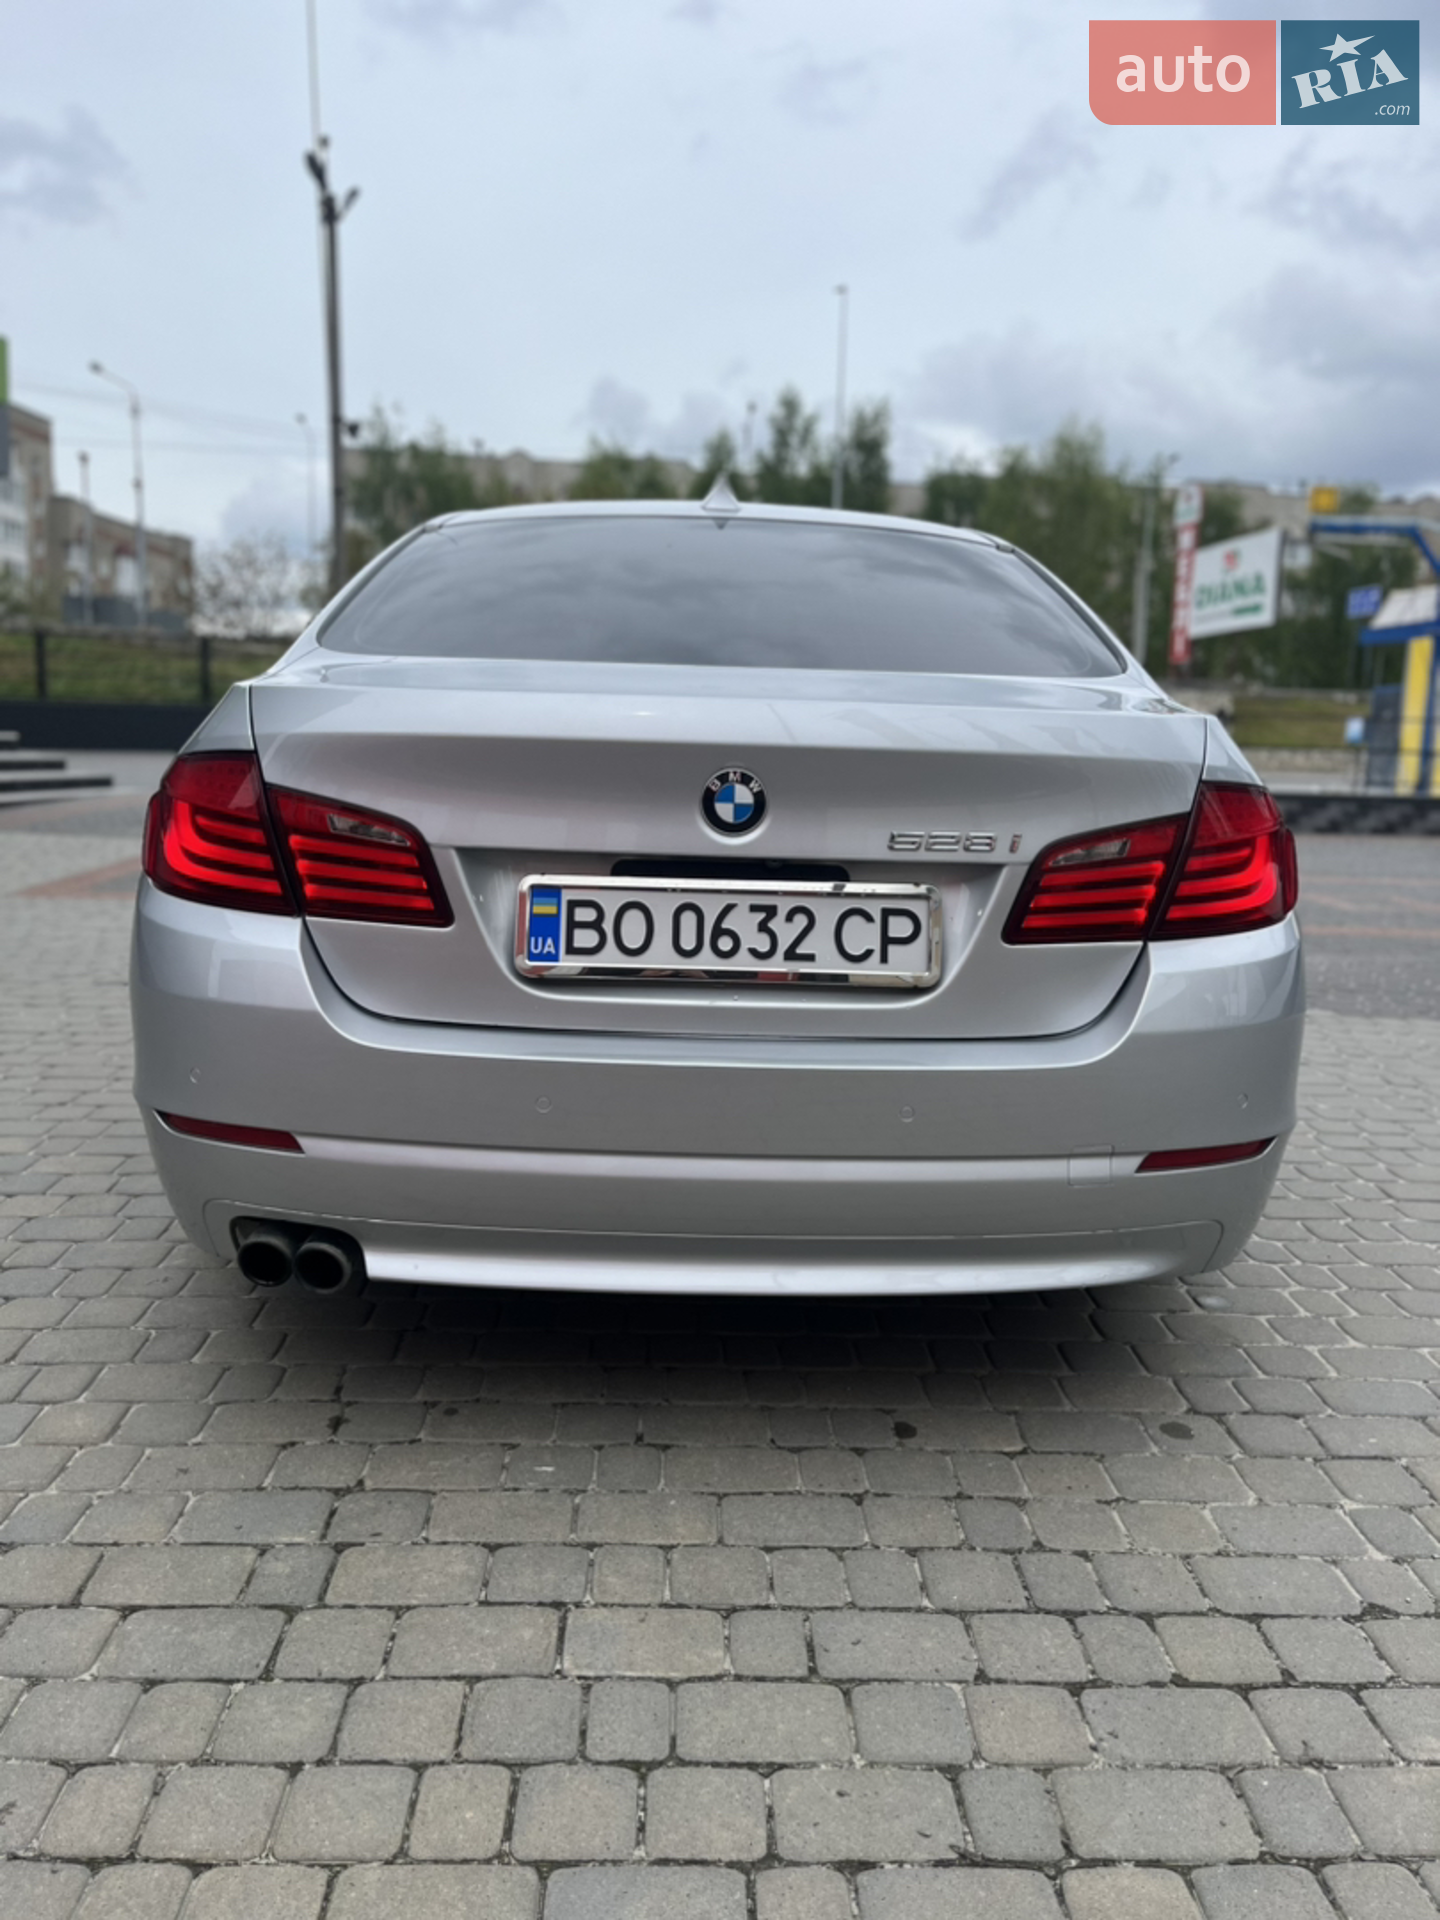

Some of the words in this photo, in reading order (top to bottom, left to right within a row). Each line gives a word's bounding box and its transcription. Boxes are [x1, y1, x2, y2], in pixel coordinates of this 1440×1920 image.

[1194, 570, 1266, 611] DIANA
[708, 770, 762, 794] BMW
[530, 936, 556, 955] UA
[565, 898, 655, 957] BO
[671, 902, 817, 962] 0632
[833, 906, 922, 964] CP
